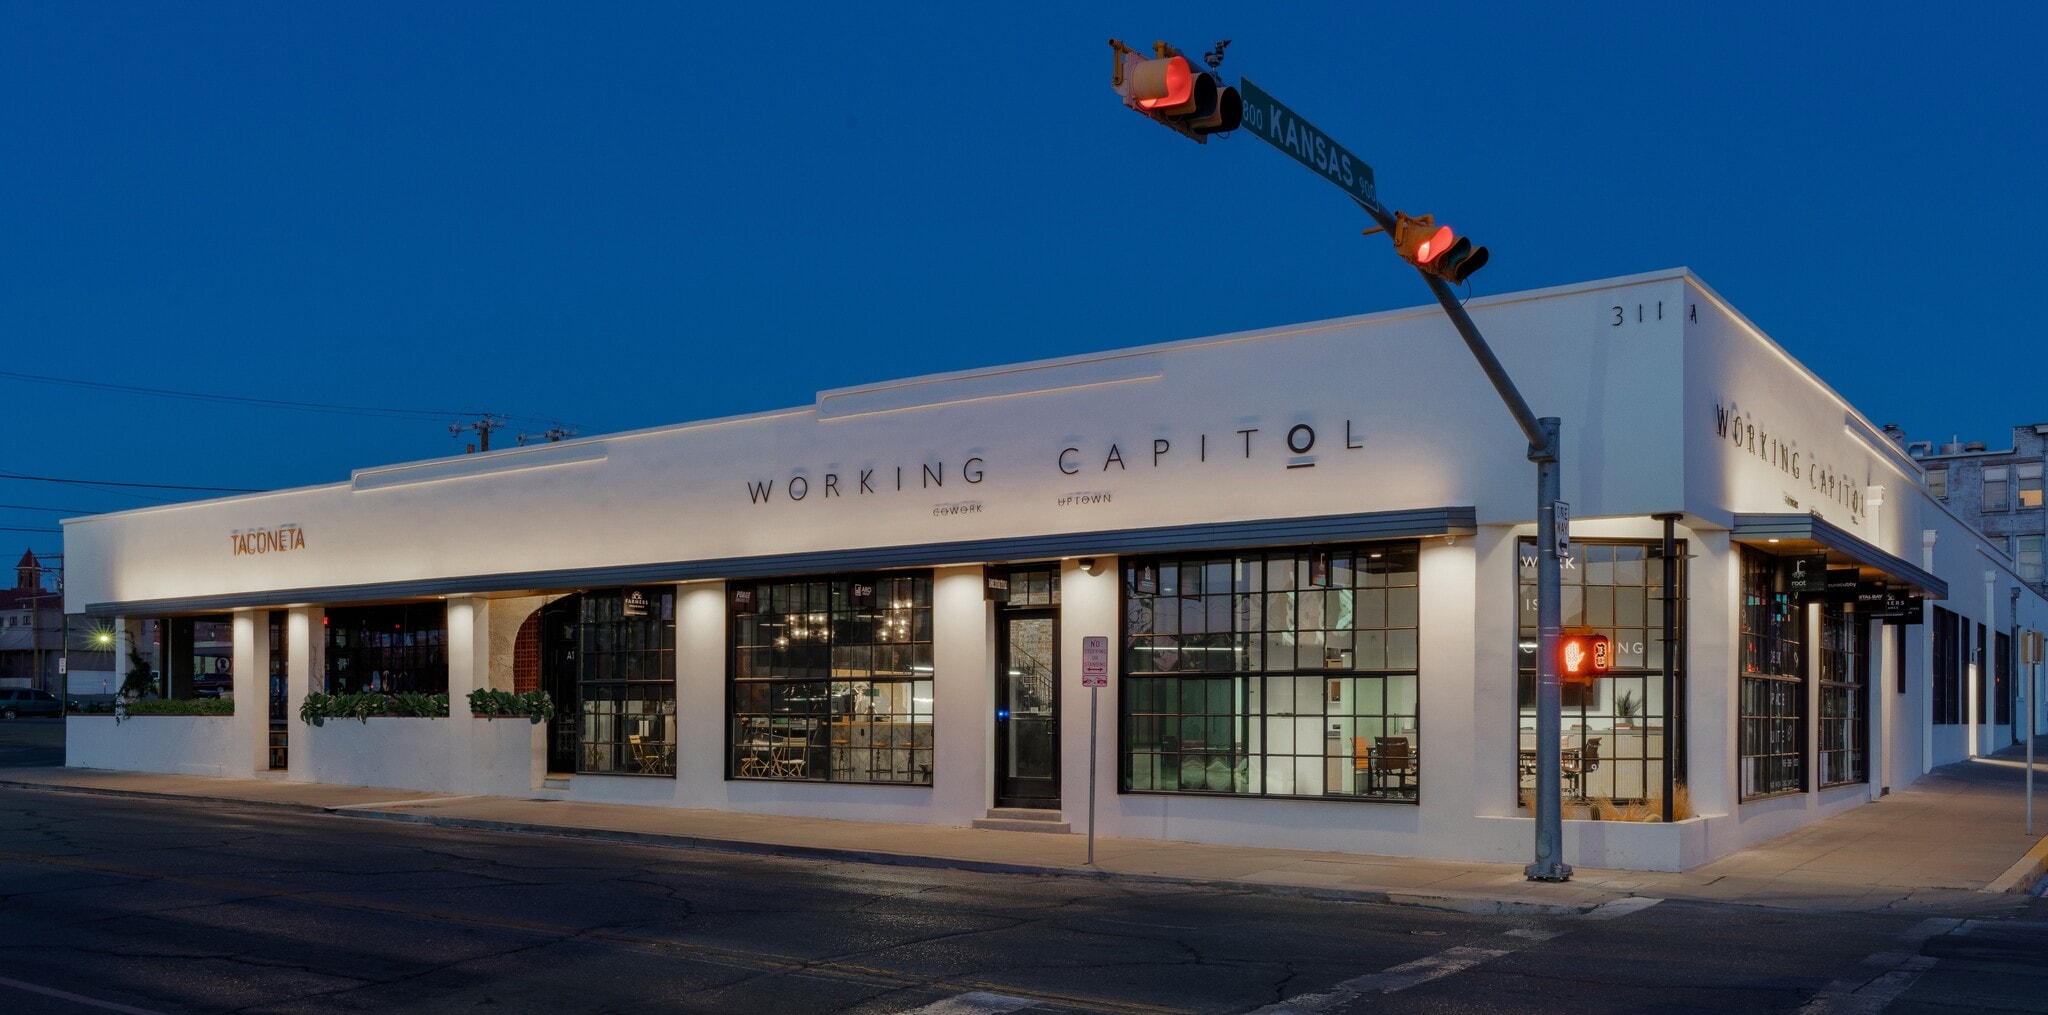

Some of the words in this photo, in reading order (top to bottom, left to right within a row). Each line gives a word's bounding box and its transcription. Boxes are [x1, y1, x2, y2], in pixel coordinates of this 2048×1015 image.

[1242, 100, 1263, 130] 800
[1269, 103, 1354, 187] KANSAS
[1359, 176, 1376, 202] 900
[1612, 300, 1662, 326] 311
[1689, 303, 1698, 324] A
[747, 457, 984, 505] WORKING
[1058, 419, 1363, 475] CAPITOL
[1715, 403, 1800, 480] WORKING
[1809, 463, 1866, 518] CAPITOL
[932, 503, 982, 516] COWORK
[1057, 494, 1112, 507] UPTOWN
[1556, 505, 1568, 521] ONE
[1556, 522, 1568, 536] WAY
[230, 527, 306, 556] TACONETA
[1522, 556, 1576, 570] WRK
[1090, 640, 1101, 648] NO
